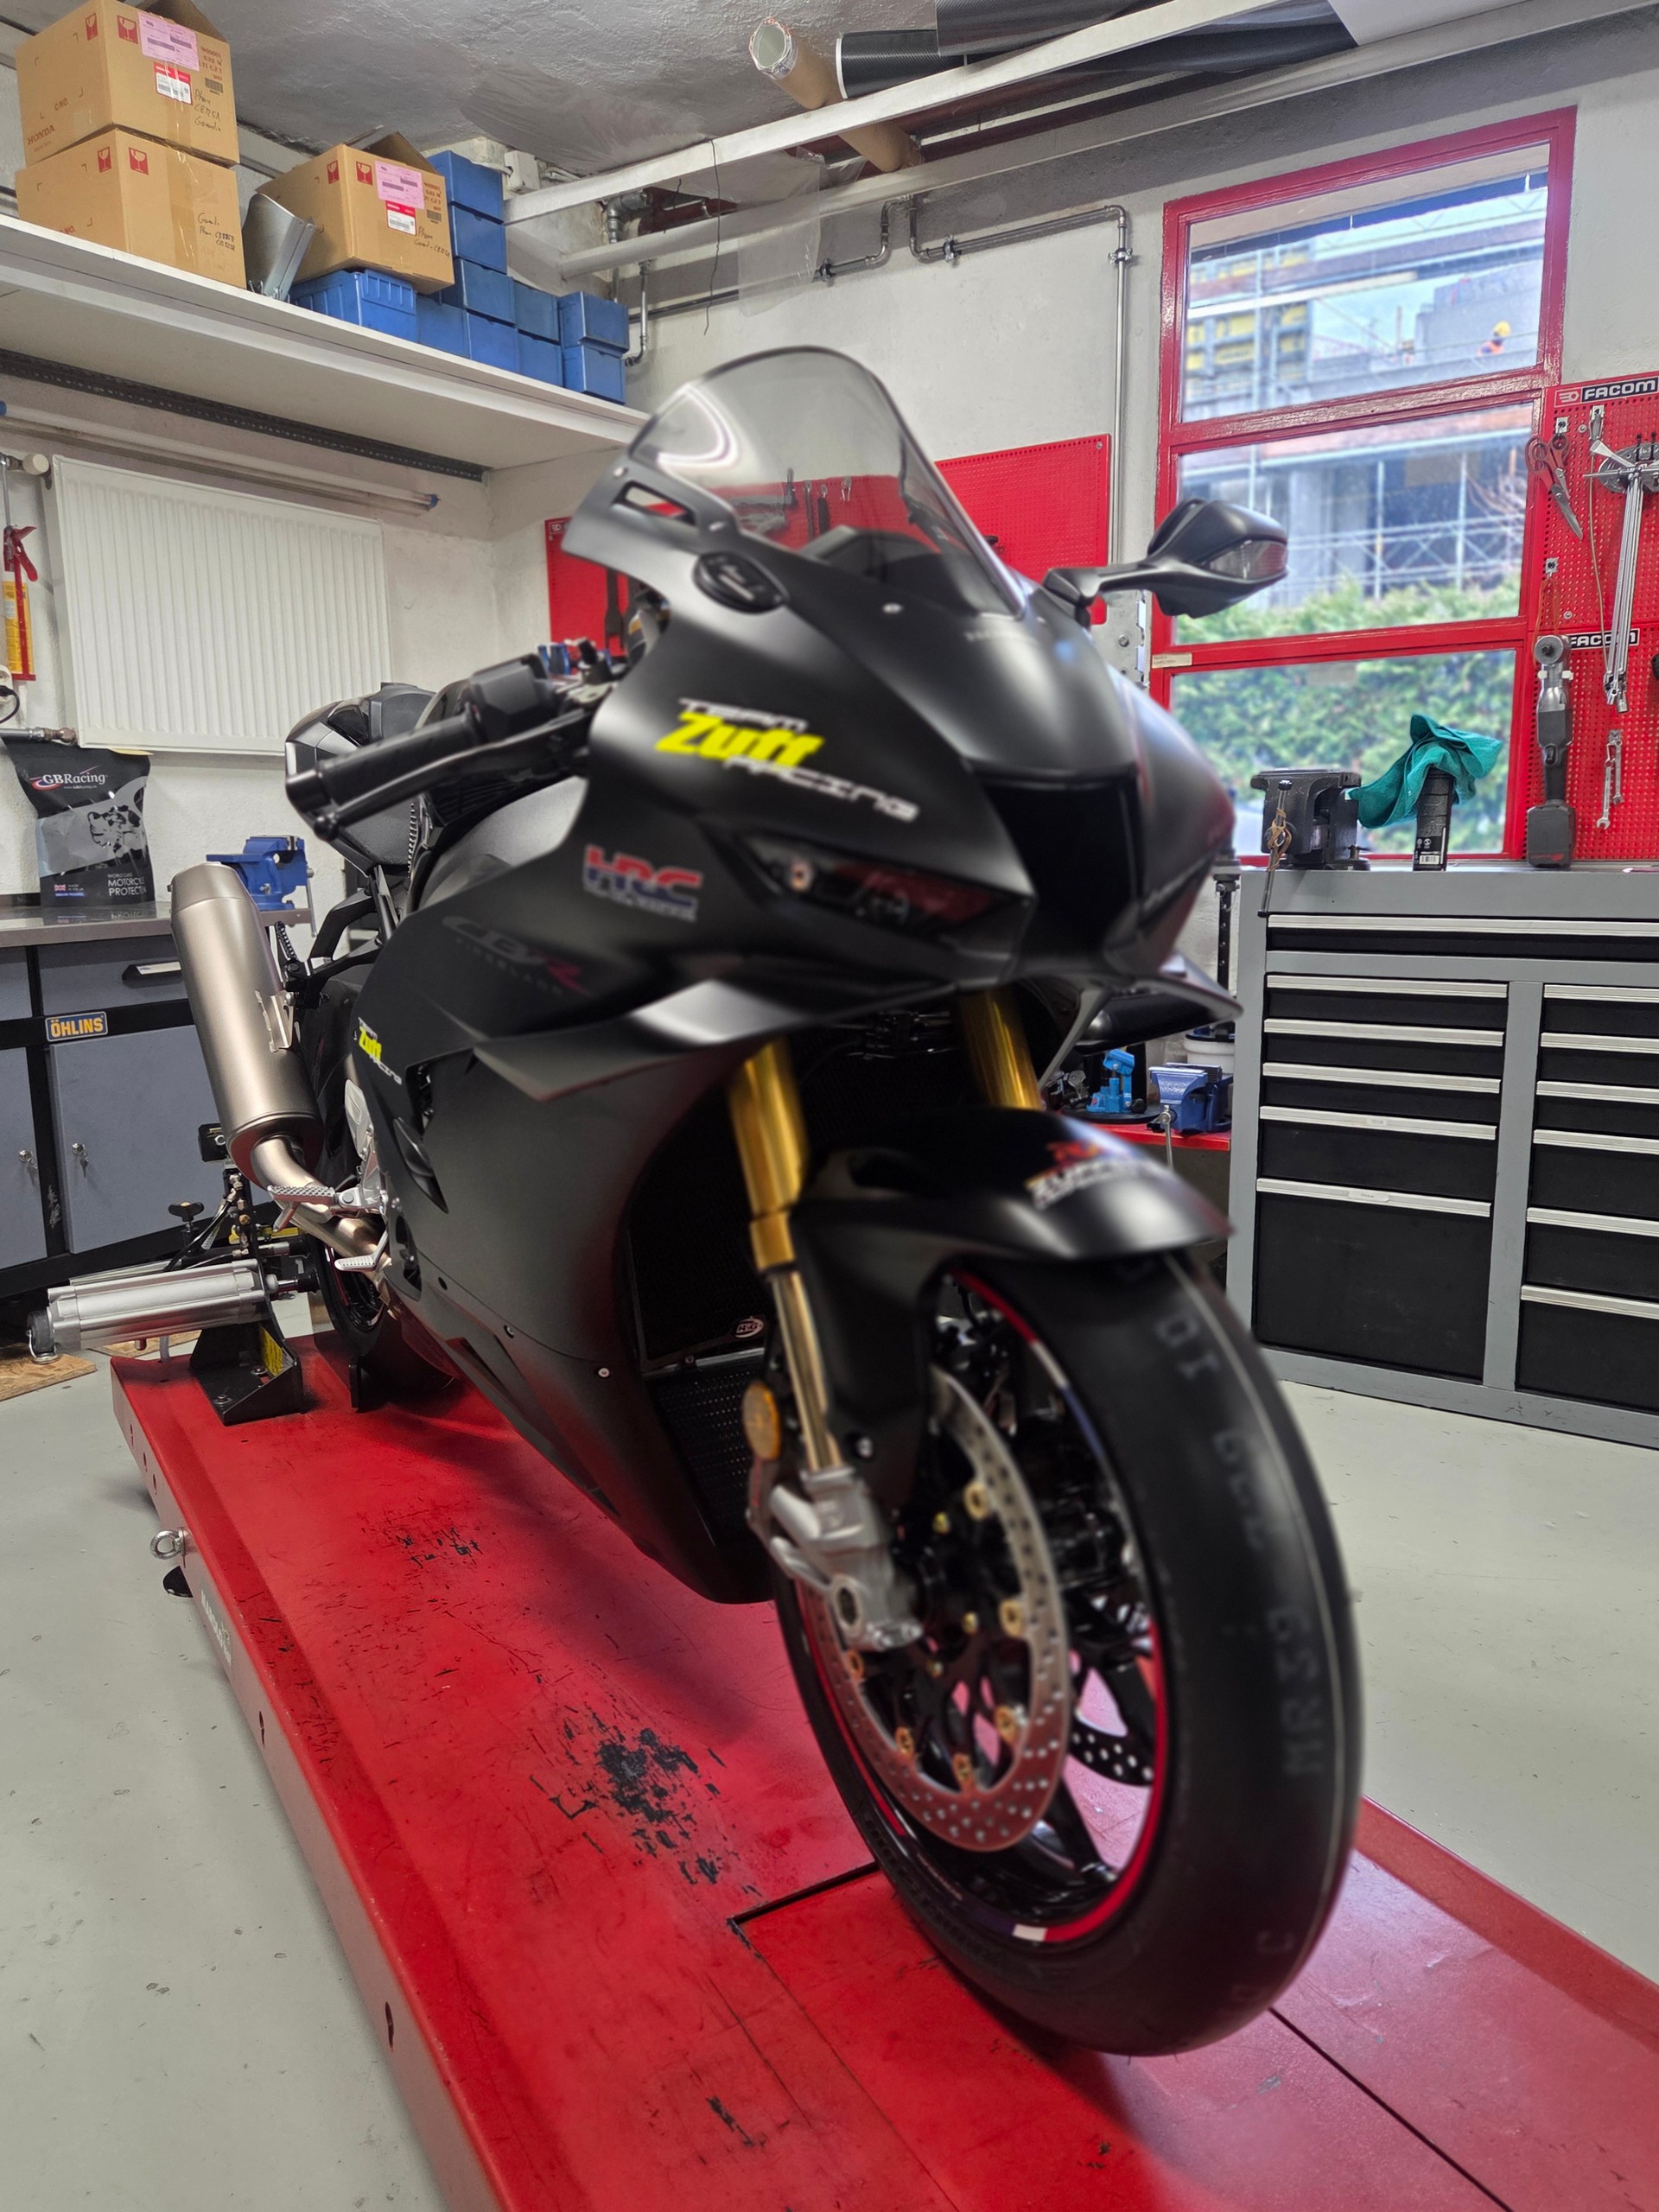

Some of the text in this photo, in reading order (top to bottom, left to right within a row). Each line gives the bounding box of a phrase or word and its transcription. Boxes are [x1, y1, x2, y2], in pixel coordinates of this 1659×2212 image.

[28, 124, 55, 145] HONDA
[1584, 380, 1656, 400] FACOM
[655, 711, 824, 767] Zuff
[42, 772, 105, 785] GBRacing
[583, 844, 703, 907] HRC
[50, 1017, 104, 1038] ÖHLINS
